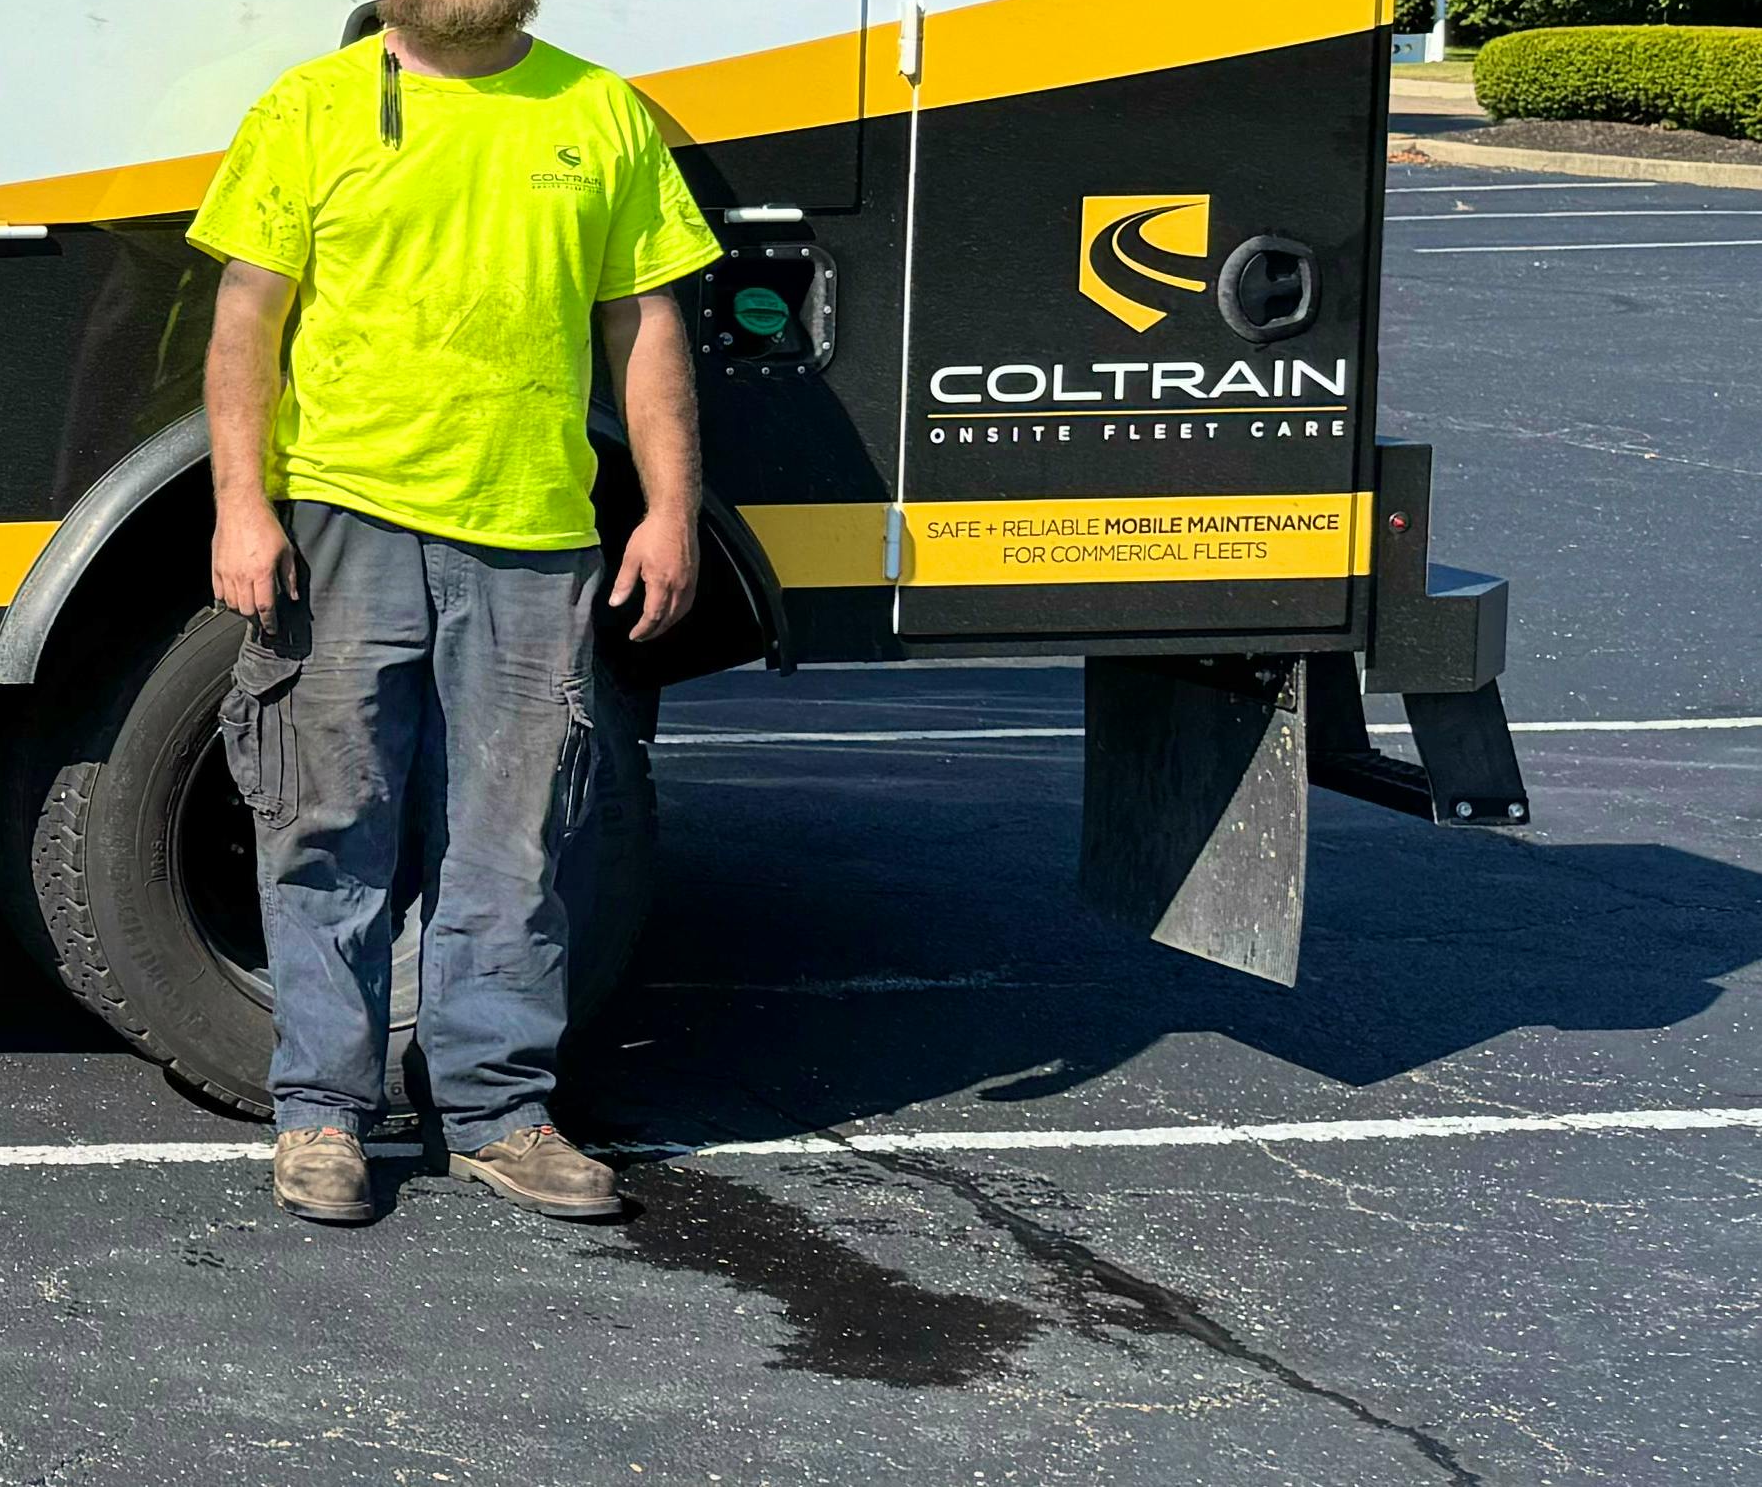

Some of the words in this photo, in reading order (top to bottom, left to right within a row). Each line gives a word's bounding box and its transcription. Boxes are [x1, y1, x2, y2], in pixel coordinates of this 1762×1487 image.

[530, 173, 602, 187] COLTRAIN
[929, 358, 1346, 404] COLTRAIN
[929, 425, 1071, 444] ONSITE
[1103, 422, 1219, 441] FLEET
[1250, 420, 1345, 438] CARE
[927, 520, 981, 539] SAFE
[985, 524, 997, 535] +
[1002, 518, 1100, 537] RELIABLE
[1104, 516, 1183, 535] MOBILE
[1187, 513, 1340, 534] MAINTENANCE
[1003, 546, 1046, 564] FOR
[1050, 543, 1189, 563] COMMERICAL
[1193, 541, 1268, 560] FLEETS
